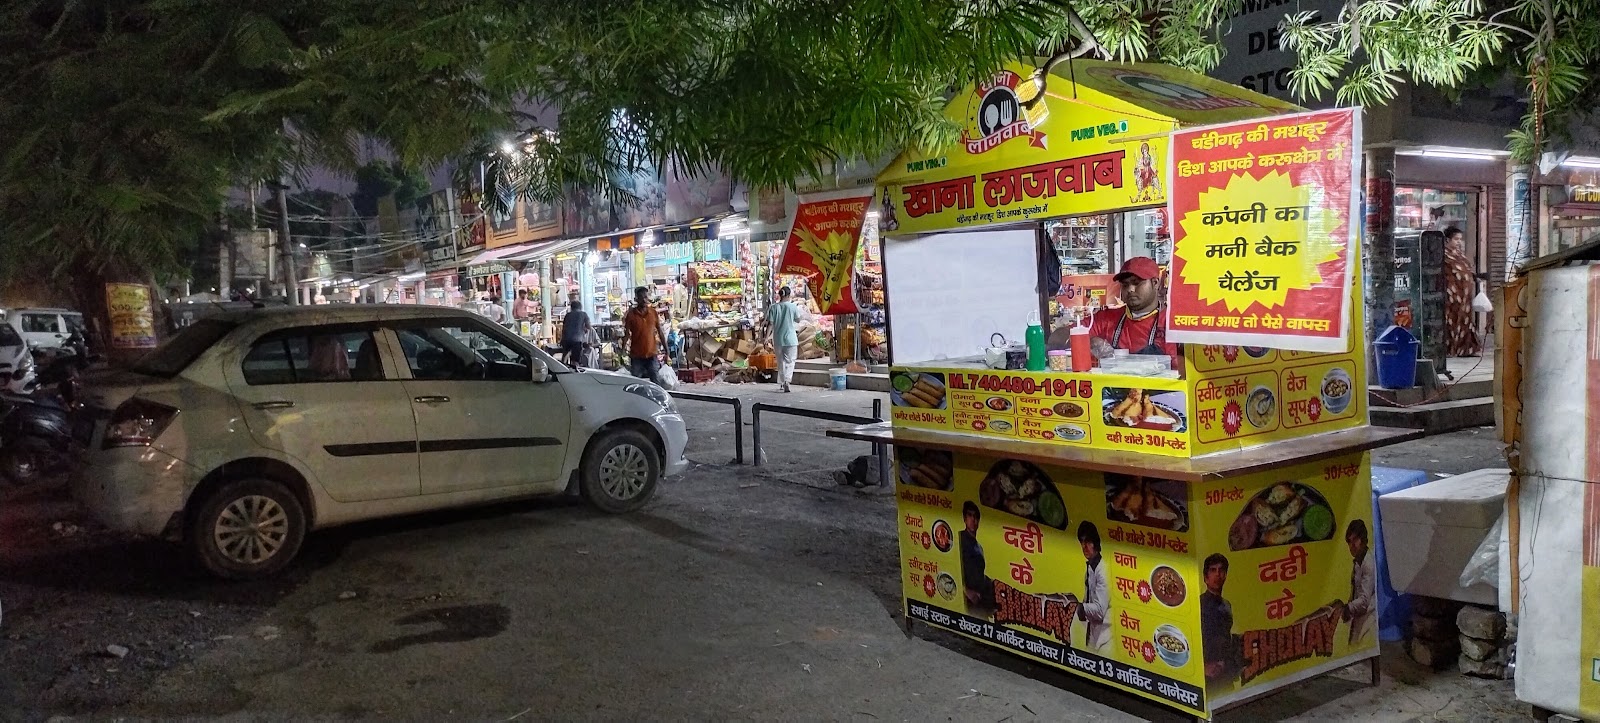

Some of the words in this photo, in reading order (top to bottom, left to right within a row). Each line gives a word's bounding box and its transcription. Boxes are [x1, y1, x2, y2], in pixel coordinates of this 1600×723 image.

[1071, 126, 1095, 142] PURE
[1191, 131, 1243, 151] चंडीगढ़
[1247, 123, 1269, 143] की
[1272, 121, 1328, 143] मशहूर
[1177, 159, 1205, 178] डिश
[1208, 152, 1255, 175] आपके
[1327, 140, 1348, 161] में
[902, 176, 977, 219] खाना
[1202, 201, 1268, 227] कंपनी
[1274, 204, 1314, 223] का
[1205, 236, 1249, 259] मनी
[1254, 235, 1301, 257] बैक
[1394, 256, 1412, 264] oritos
[1217, 269, 1281, 292] चैलेंज
[1174, 314, 1199, 328] स्वाद
[1201, 315, 1215, 327] ना
[1216, 316, 1240, 328] आए
[1242, 313, 1258, 328] तो
[1261, 313, 1284, 329] पैसे
[1286, 318, 1331, 332] वापस
[948, 373, 1093, 399] M.740480-1915
[1197, 381, 1223, 402] स्वीट
[1224, 376, 1248, 397] कॉर्न
[1286, 370, 1307, 393] वैज
[1020, 406, 1038, 416] सूप
[1198, 408, 1216, 430] सूप
[1287, 399, 1307, 424] सूप
[1023, 428, 1041, 438] सूप
[1106, 431, 1122, 443] दही
[1124, 432, 1144, 445] शोले
[1205, 487, 1245, 506] 50/-प्लेट
[910, 530, 921, 545] सूप
[1003, 522, 1044, 554] दही
[1009, 557, 1035, 585] के
[1114, 551, 1137, 570] चना
[1258, 545, 1309, 583] दही
[909, 572, 920, 587] सूप
[1115, 576, 1136, 599] सूप
[993, 578, 1079, 647] SHOLAY
[1265, 587, 1296, 620] के
[1120, 609, 1141, 632] वैज
[930, 609, 951, 625] स्टाल
[958, 616, 982, 636] सेक्टर
[982, 623, 995, 639] 17
[996, 629, 1025, 649] मार्किट
[1025, 639, 1059, 660] थानेसर
[1067, 650, 1098, 673] सेक्टर
[1098, 660, 1114, 678] 13
[1116, 667, 1153, 691] मार्किट
[1157, 682, 1200, 707] थानेसर
[1121, 635, 1141, 659] सूप
[1241, 606, 1342, 687] SHOLAY
